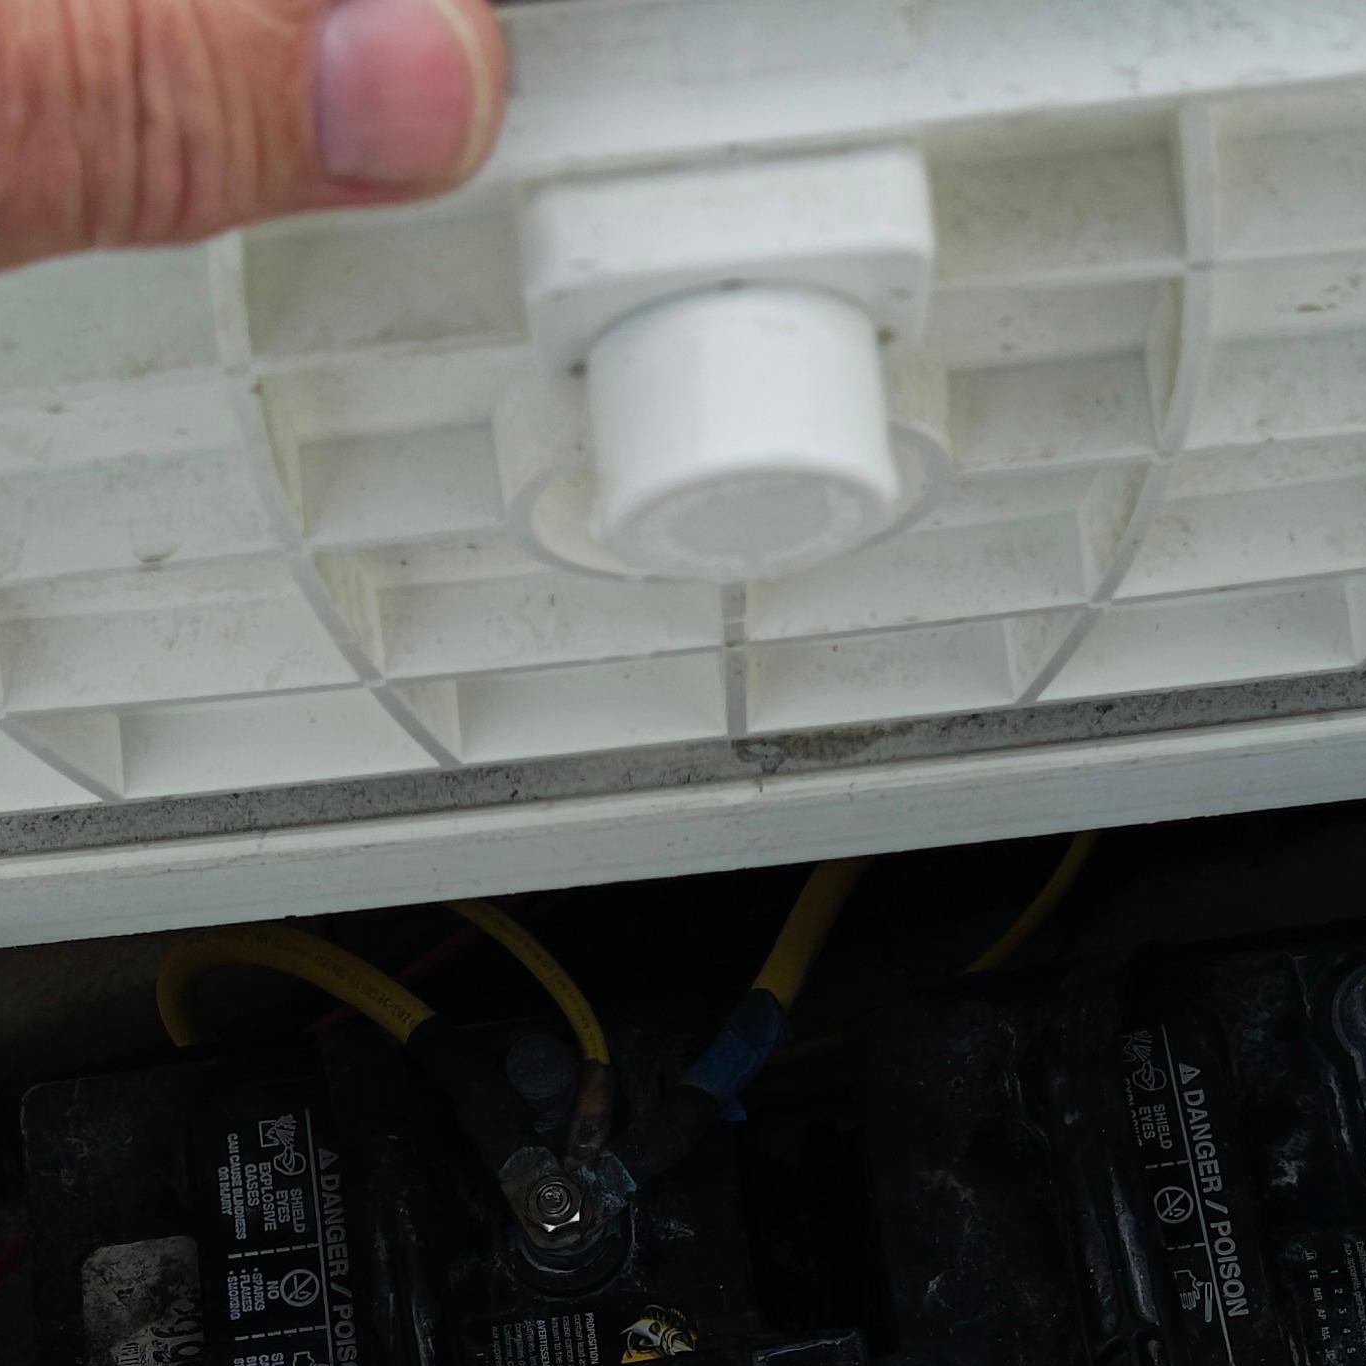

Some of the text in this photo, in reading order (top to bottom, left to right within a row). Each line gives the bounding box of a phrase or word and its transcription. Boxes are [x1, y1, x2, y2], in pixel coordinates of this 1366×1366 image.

[1138, 1105, 1156, 1140] EYES
[1153, 1104, 1173, 1149] SHIELD
[218, 1167, 233, 1215] OR INJURY
[228, 1133, 247, 1240] CAN CAUSE BLINDNESS
[245, 1164, 259, 1206] GASES
[259, 1162, 277, 1231] EXPLOSIVE
[276, 1191, 290, 1223] EYES
[1183, 1088, 1249, 1318] DANGER / POISON
[290, 1189, 305, 1233] SHIELD
[321, 1174, 350, 1278] DANGER
[267, 1281, 280, 1300] NO
[331, 1283, 352, 1298] /
[585, 1312, 599, 1365] PROPOSITION
